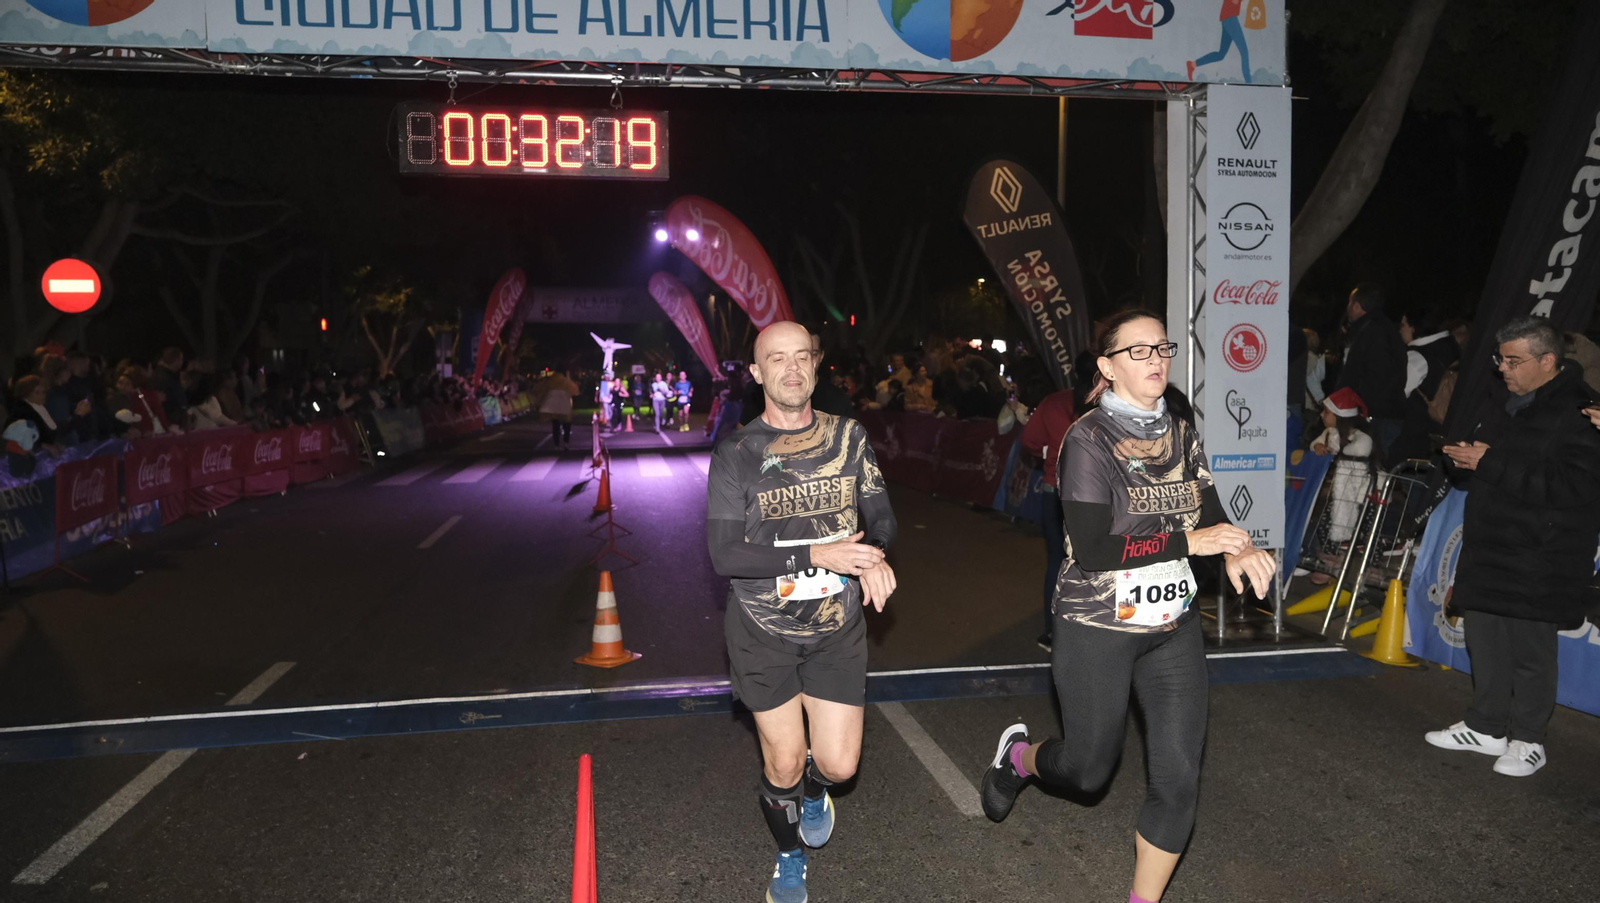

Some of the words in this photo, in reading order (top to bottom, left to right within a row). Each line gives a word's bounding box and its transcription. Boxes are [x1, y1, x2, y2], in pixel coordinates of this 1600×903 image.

[484, 0, 558, 34] DE
[443, 111, 657, 171] 00:32:19
[1217, 157, 1278, 169] RENAULT
[1217, 169, 1236, 177] SYRSA
[1237, 170, 1277, 178] AUTOMOCION
[1218, 222, 1274, 231] NISSAN
[1223, 253, 1272, 261] andalmotor.es
[1213, 279, 1283, 305] Coca-Cola
[1214, 457, 1256, 469] Almericar
[757, 477, 841, 506] RUNNERS
[1127, 482, 1192, 499] RUNNERS
[760, 492, 841, 519] FOREVER
[1128, 494, 1195, 512] FOREVER
[1129, 579, 1189, 604] 1089
